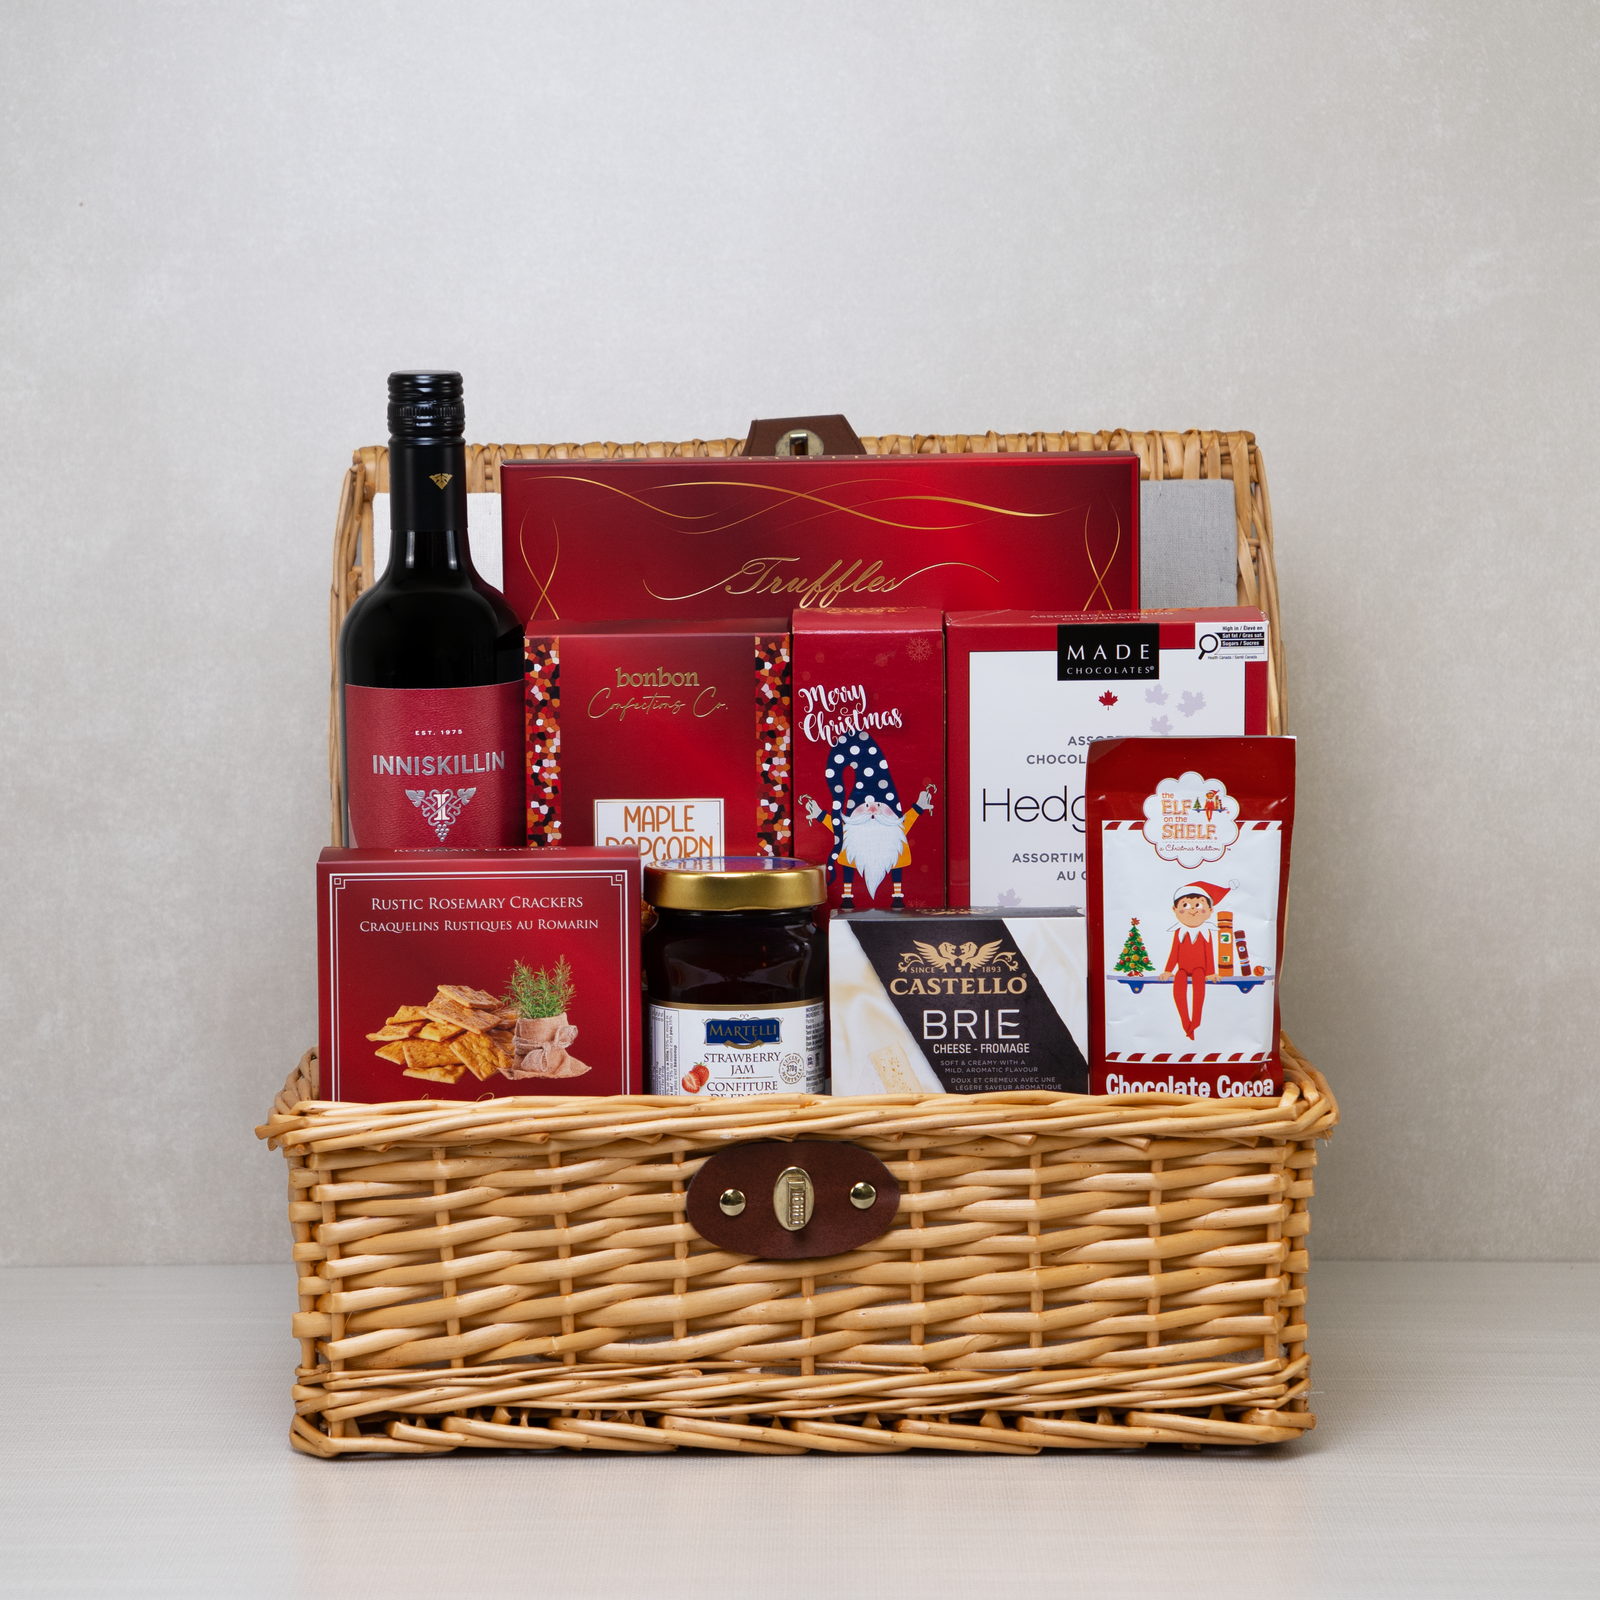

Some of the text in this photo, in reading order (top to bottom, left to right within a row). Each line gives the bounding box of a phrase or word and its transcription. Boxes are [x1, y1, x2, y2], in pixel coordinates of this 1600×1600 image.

[725, 557, 903, 608] Truffles
[1067, 644, 1150, 660] MADE
[615, 666, 700, 688] bonbon
[587, 686, 728, 722] Confections Co.
[798, 684, 867, 714] Merry
[798, 708, 902, 747] Christmas
[372, 750, 504, 776] INNISKILLIN
[1162, 799, 1192, 816] ELF
[624, 805, 694, 832] MAPLE
[1056, 870, 1076, 880] AU
[910, 966, 935, 974] SINCE
[890, 977, 1027, 995] CASTELLO
[709, 1024, 777, 1042] MARTELLI
[923, 1008, 1020, 1040] BRIE
[704, 1052, 782, 1063] STRAWBERRY
[933, 1044, 972, 1054] CHEESE
[980, 1043, 1030, 1054] FROMAGE
[730, 1065, 754, 1076] JAM
[706, 1081, 778, 1092] CONFITURE
[1106, 1073, 1274, 1098] Chocolate Cocoa
